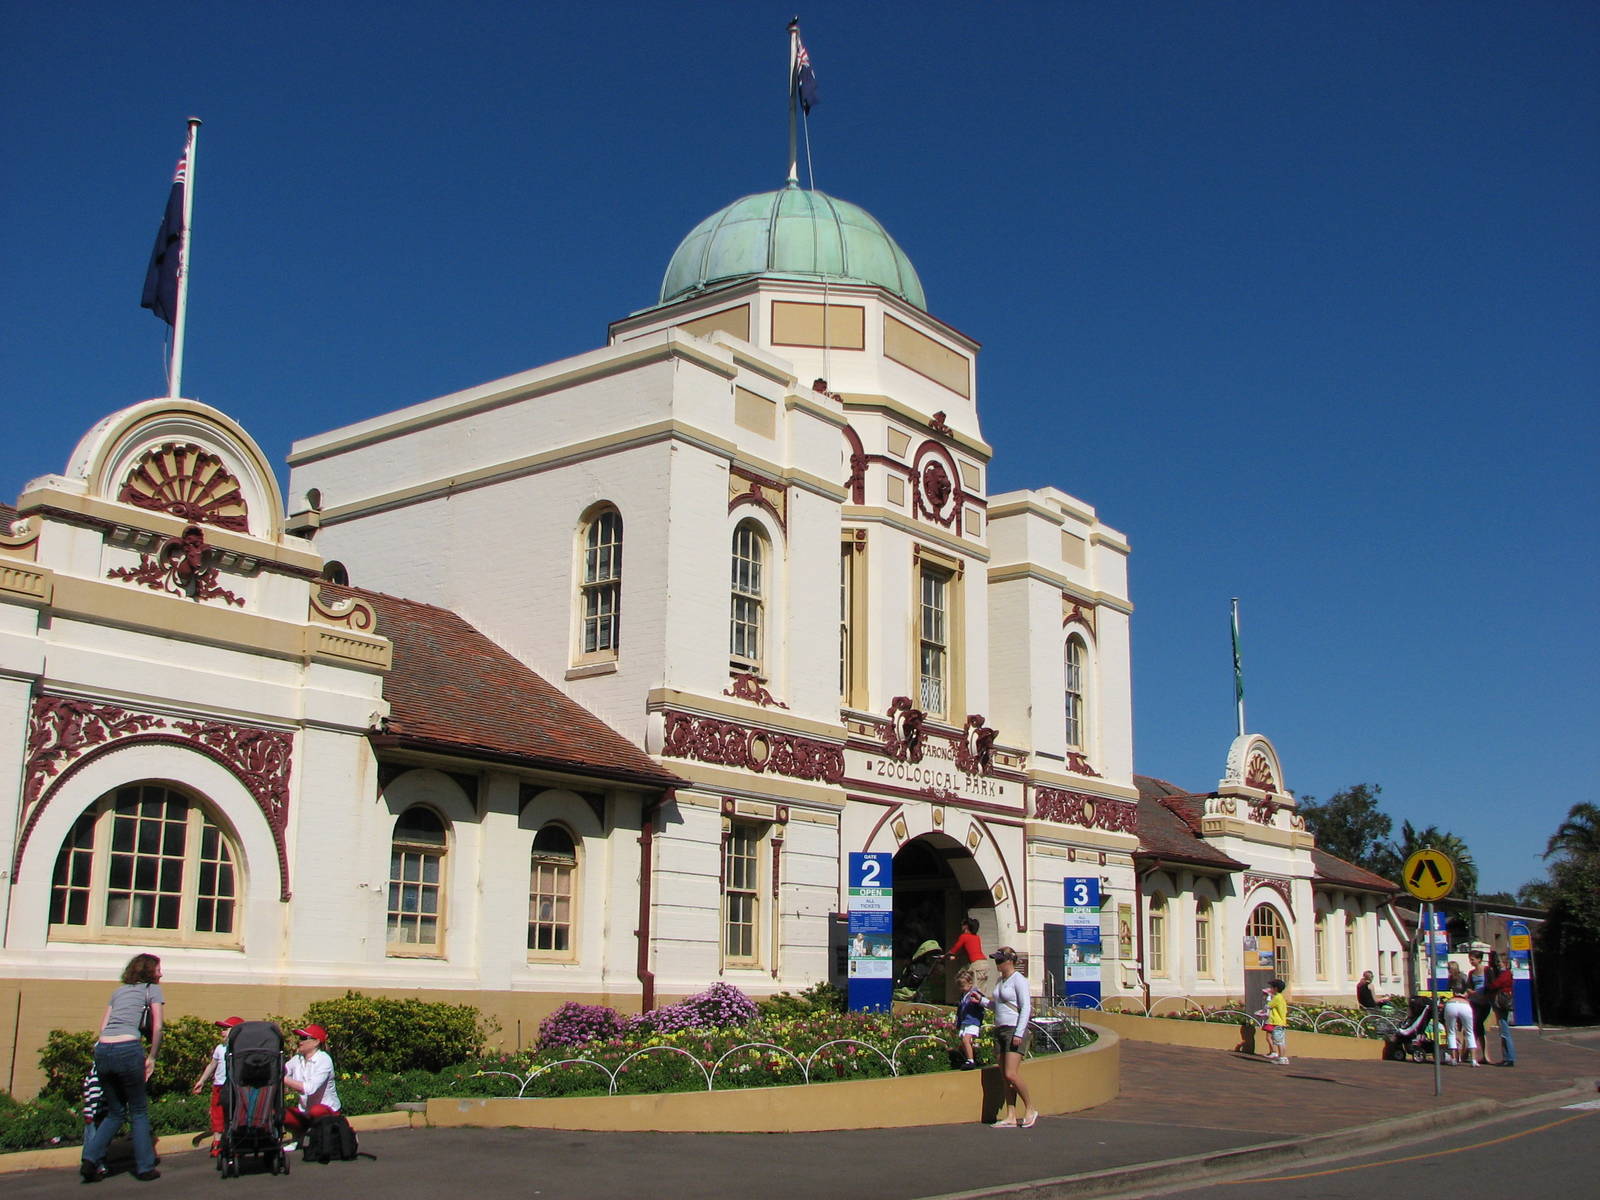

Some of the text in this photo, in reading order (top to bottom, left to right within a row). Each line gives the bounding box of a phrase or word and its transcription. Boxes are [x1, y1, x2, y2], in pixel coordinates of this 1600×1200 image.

[877, 760, 996, 797] ZOOLOGICAL PARK
[861, 860, 880, 886] 2
[860, 888, 882, 896] OPEN
[1073, 884, 1088, 905] 3
